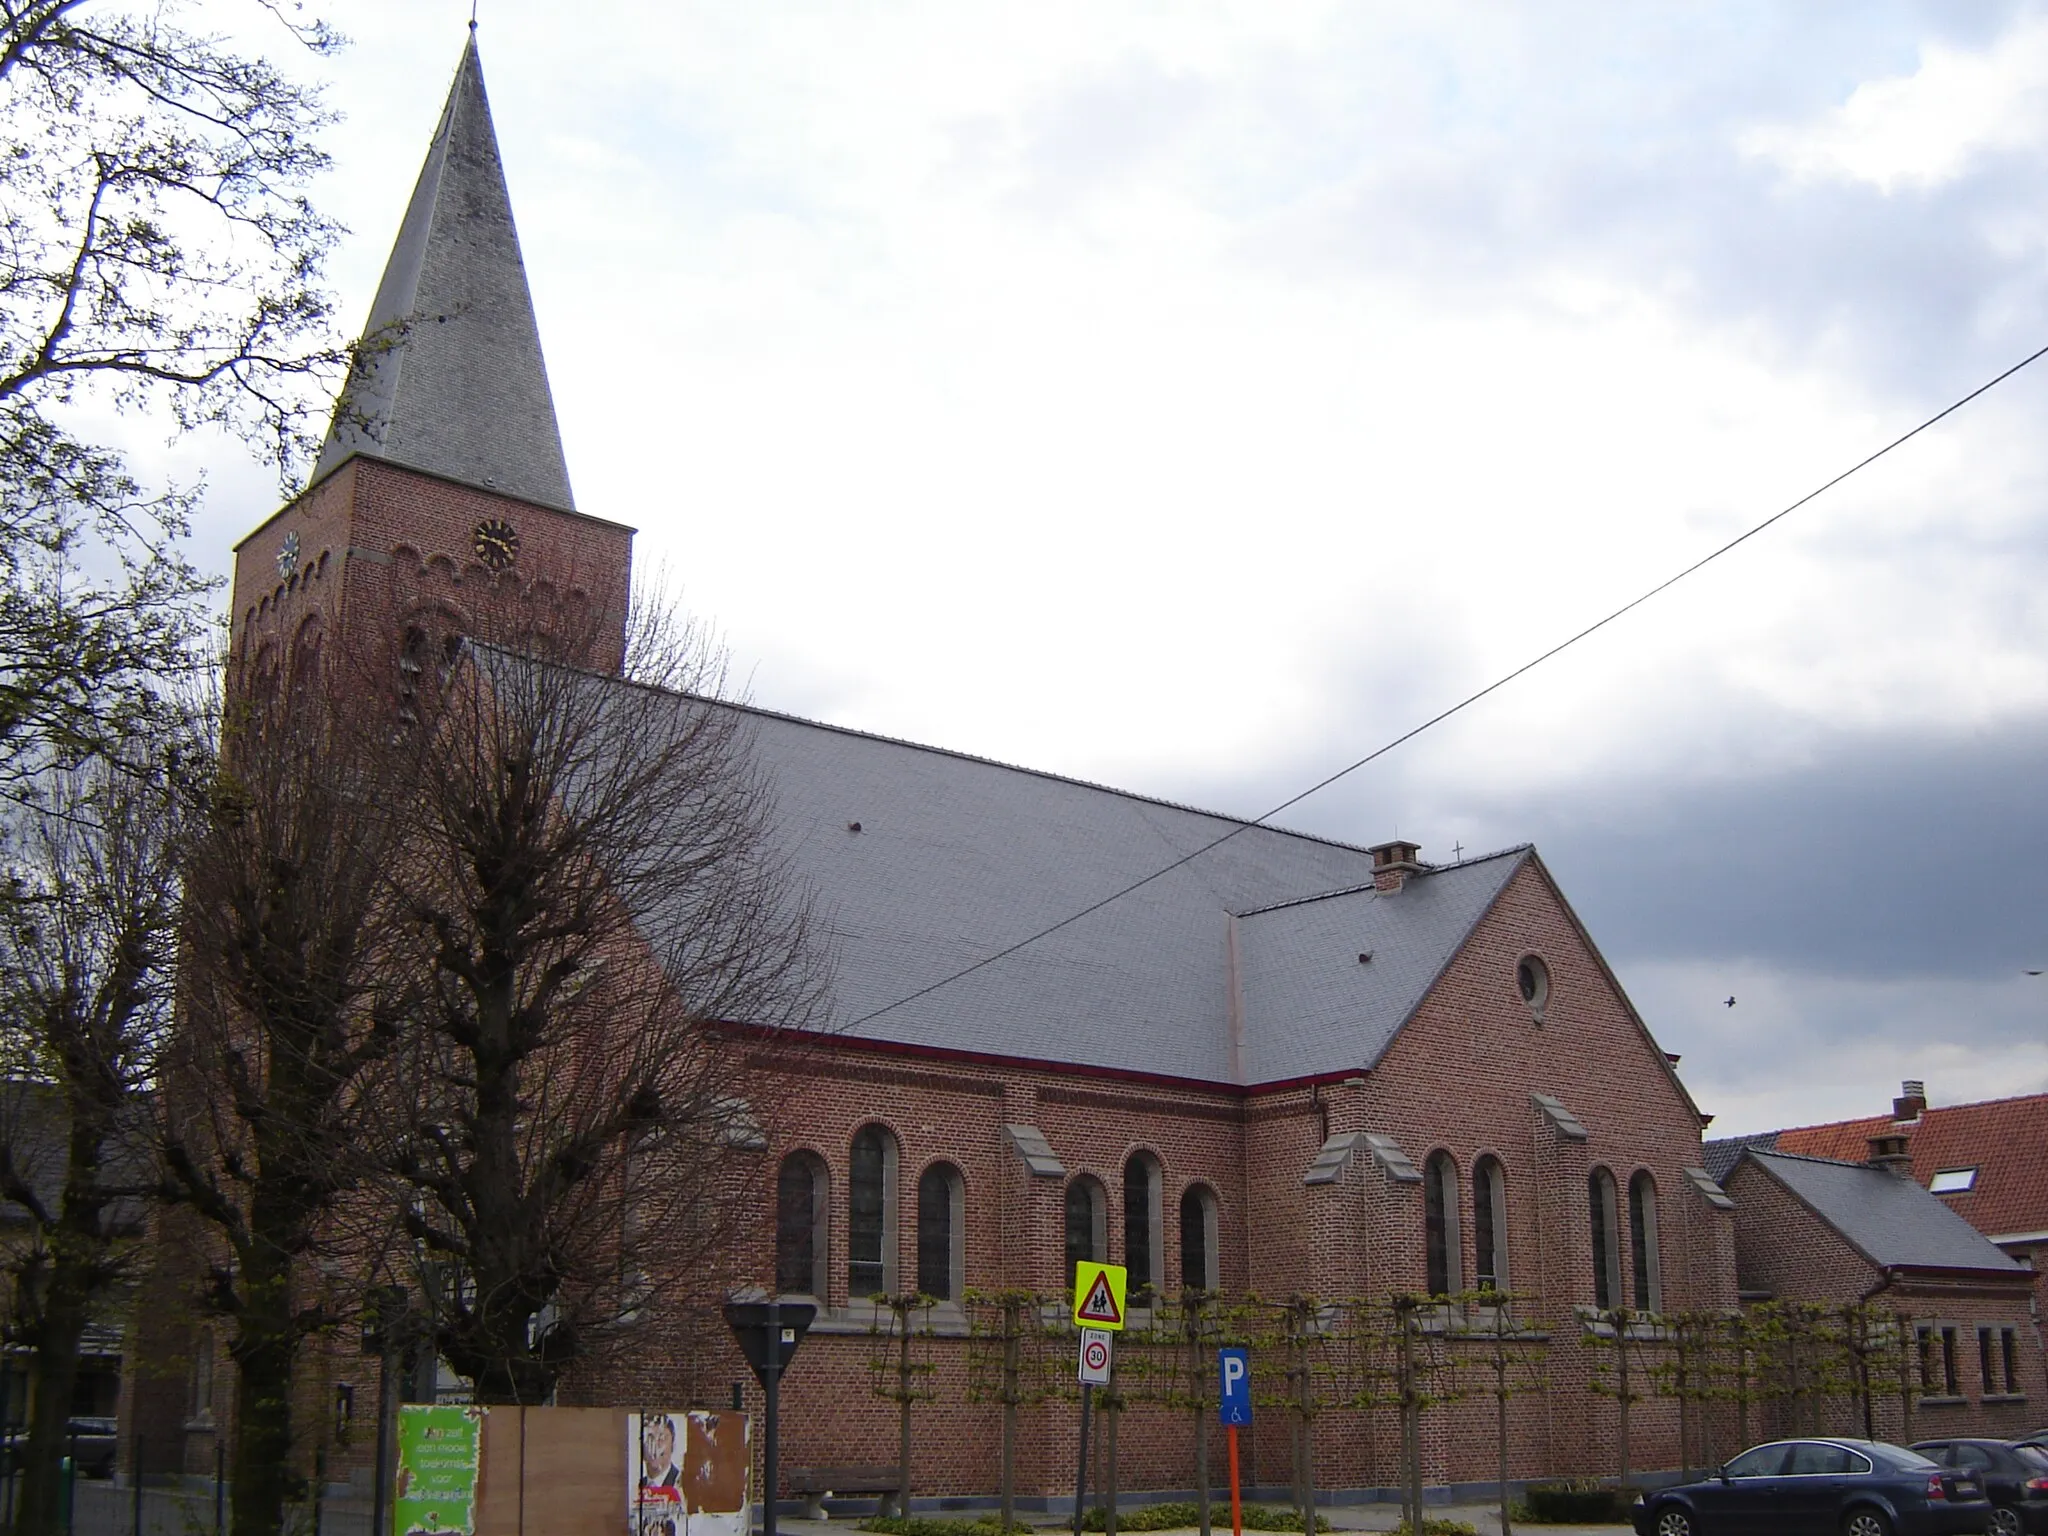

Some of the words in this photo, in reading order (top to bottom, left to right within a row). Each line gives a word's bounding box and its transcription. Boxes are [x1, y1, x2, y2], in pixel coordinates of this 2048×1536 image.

[1090, 1332, 1105, 1340] ZONE
[1090, 1350, 1103, 1361] 30
[1224, 1357, 1244, 1396] P
